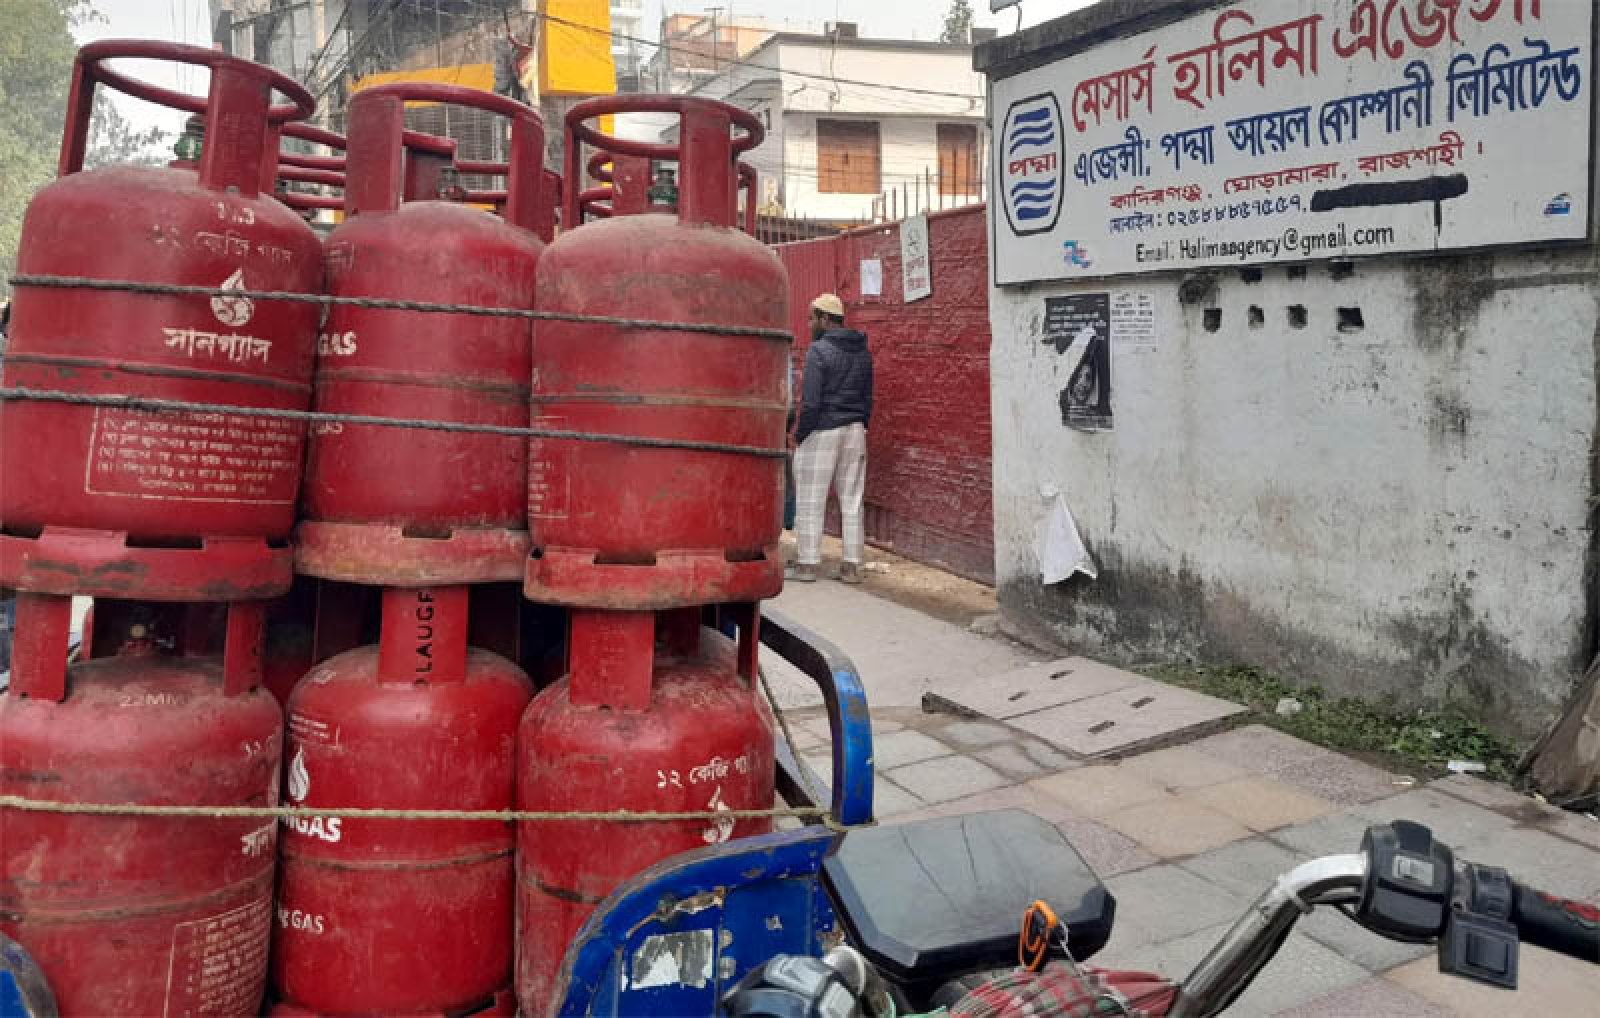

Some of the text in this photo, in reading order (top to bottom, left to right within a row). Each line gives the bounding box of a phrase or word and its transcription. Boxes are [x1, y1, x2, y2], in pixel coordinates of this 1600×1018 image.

[1072, 45, 1158, 132] মেসার্স
[1167, 10, 1323, 109] হালিমা
[1160, 125, 1214, 170] পদ্মা
[1225, 106, 1312, 156] অয়েল
[1318, 60, 1434, 146] কোম্পানী
[1446, 37, 1580, 122] লিমিটেড
[1009, 152, 1057, 176] পদ্মা
[657, 770, 683, 788] ১২
[689, 756, 729, 784] কেজি
